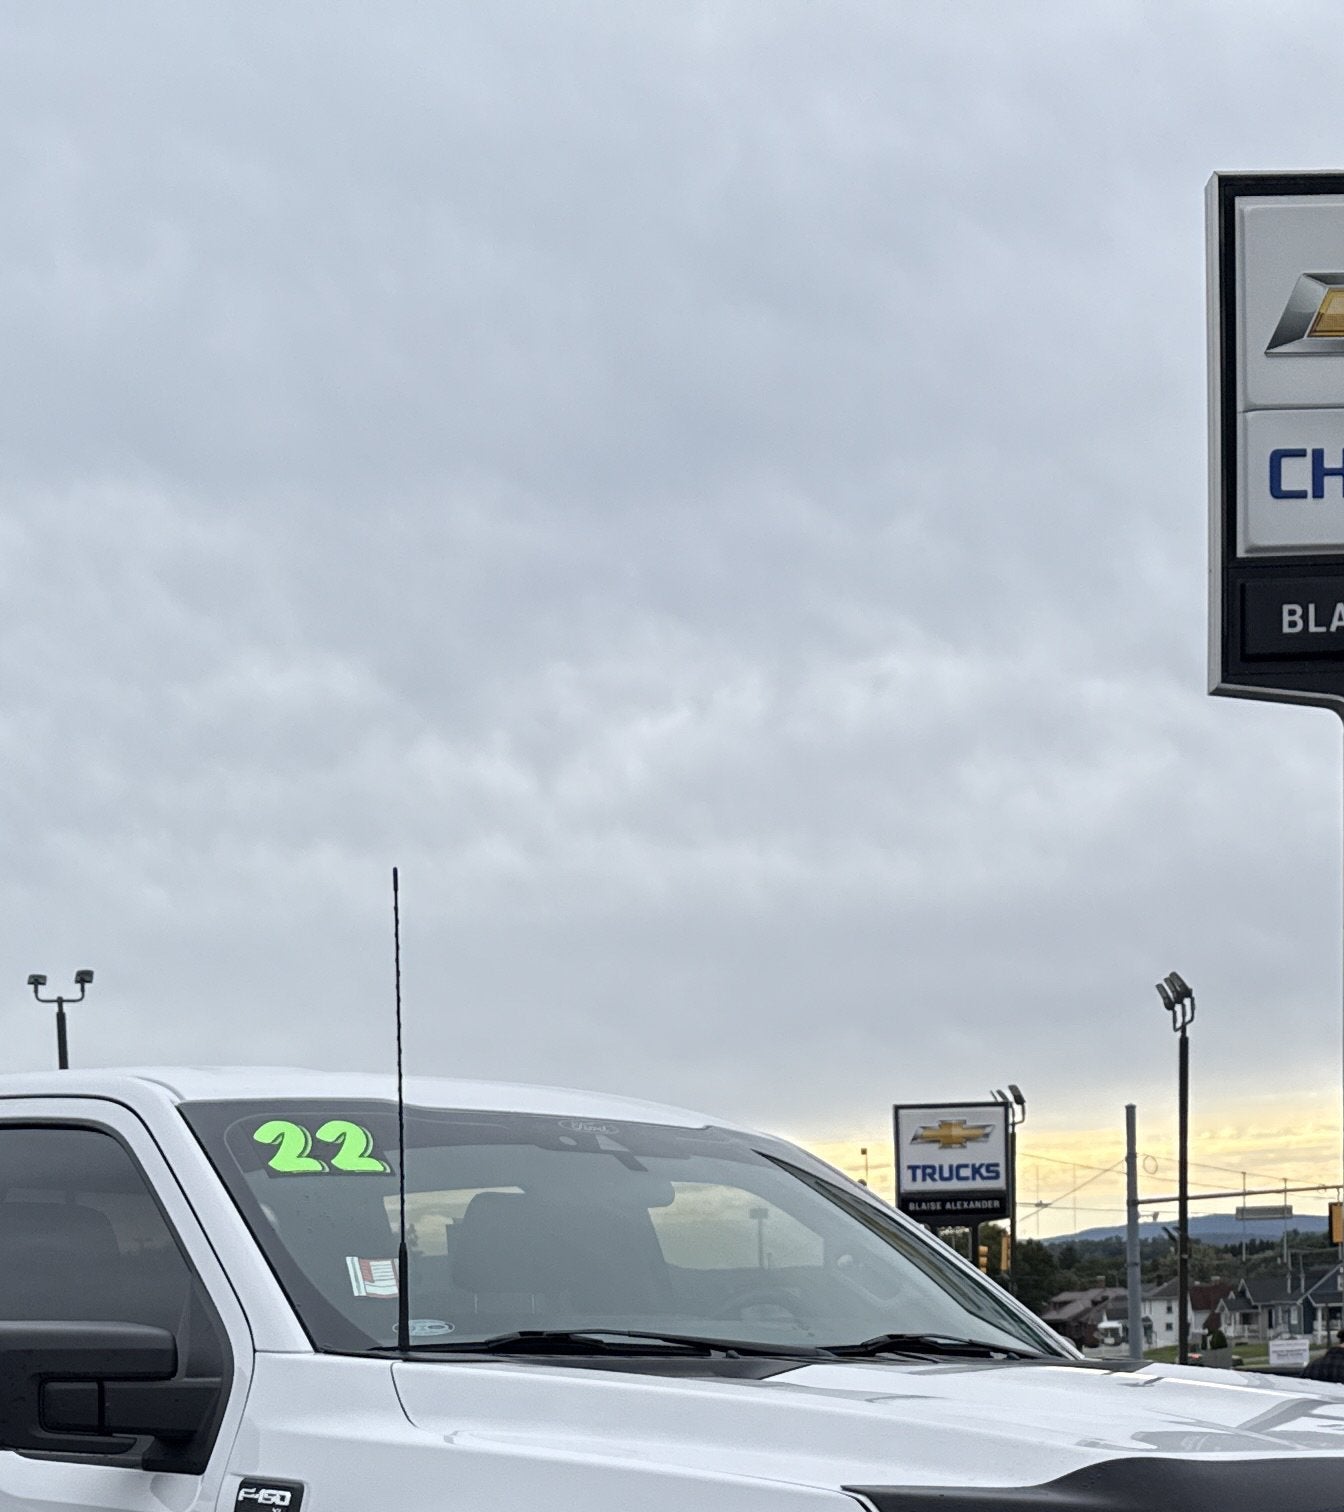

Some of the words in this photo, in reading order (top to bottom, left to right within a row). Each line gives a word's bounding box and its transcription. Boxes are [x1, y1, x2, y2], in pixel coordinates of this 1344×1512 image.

[253, 1120, 391, 1173] 22
[906, 1162, 1001, 1183] TRUCKS
[908, 1201, 942, 1211] BLAISE
[944, 1200, 1001, 1209] ALEXANDER
[237, 1487, 292, 1507] F-150
